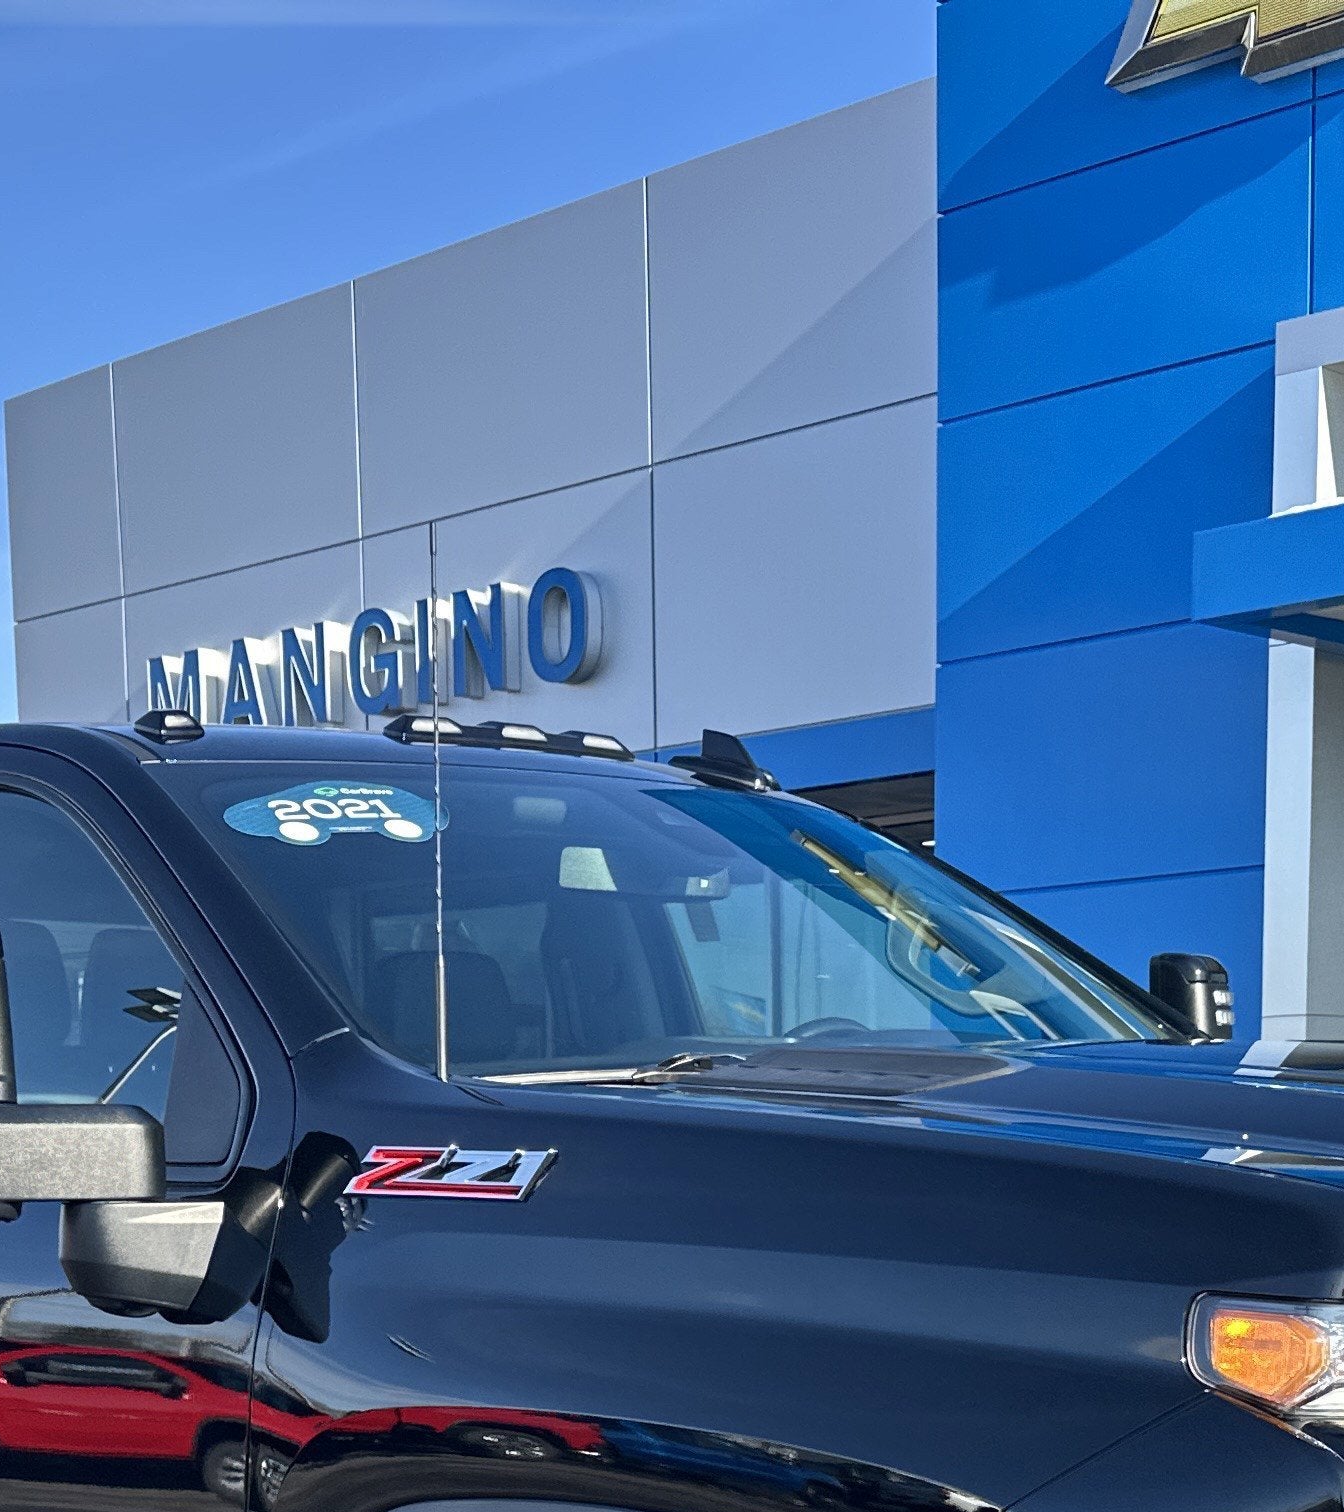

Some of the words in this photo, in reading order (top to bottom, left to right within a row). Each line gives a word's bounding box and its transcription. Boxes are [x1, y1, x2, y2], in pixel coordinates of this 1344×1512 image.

[146, 566, 594, 726] MANGINO
[267, 798, 402, 821] 2021
[342, 1144, 559, 1202] Z71
